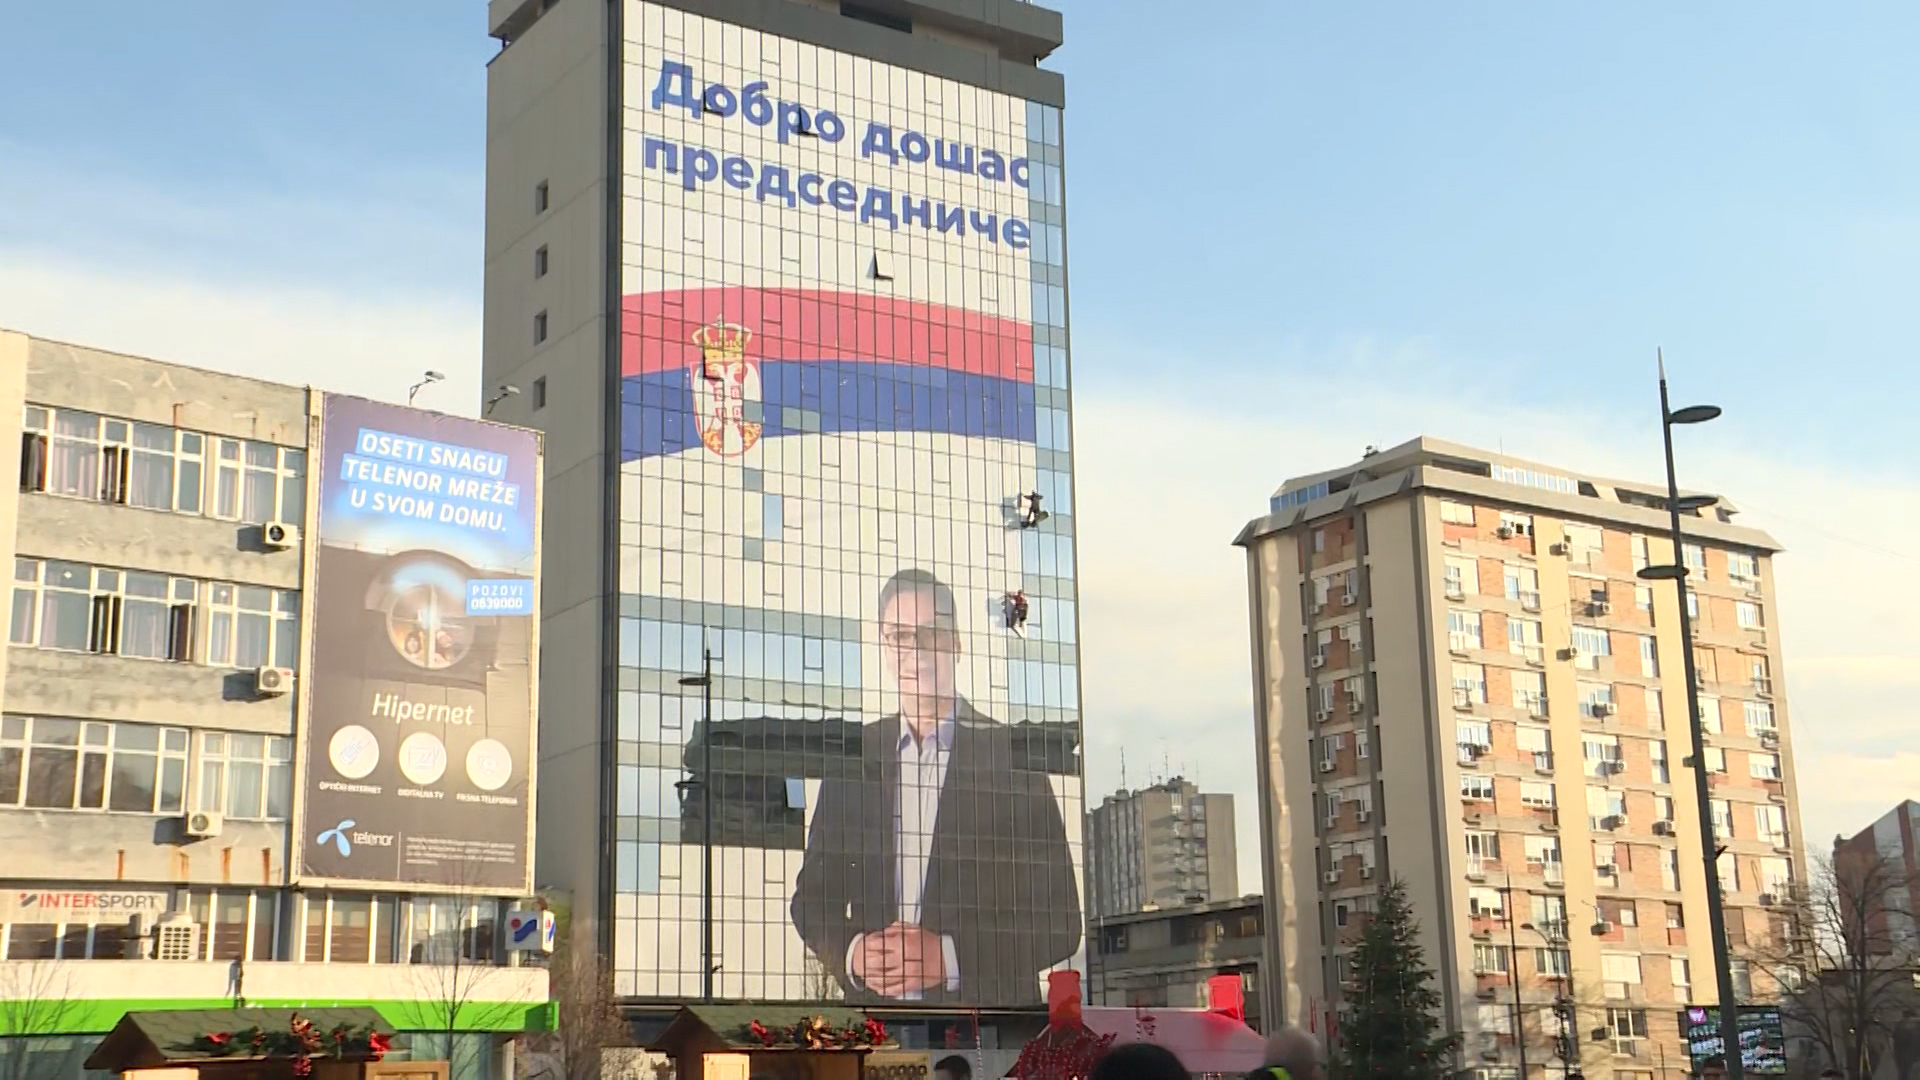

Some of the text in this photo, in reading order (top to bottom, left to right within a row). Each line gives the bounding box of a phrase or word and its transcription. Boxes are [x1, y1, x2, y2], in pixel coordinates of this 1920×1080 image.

[652, 59, 845, 144] Добро
[645, 138, 1031, 249] председниче
[362, 433, 502, 476] OSETI SNAGU
[345, 458, 516, 506] TELENOR MREŽE
[351, 488, 507, 532] U SVOM DOMU.
[472, 585, 523, 596] POZOVI
[372, 693, 474, 725] Hipernet
[353, 831, 394, 846] telenor
[39, 893, 157, 908] INTERSPORT
